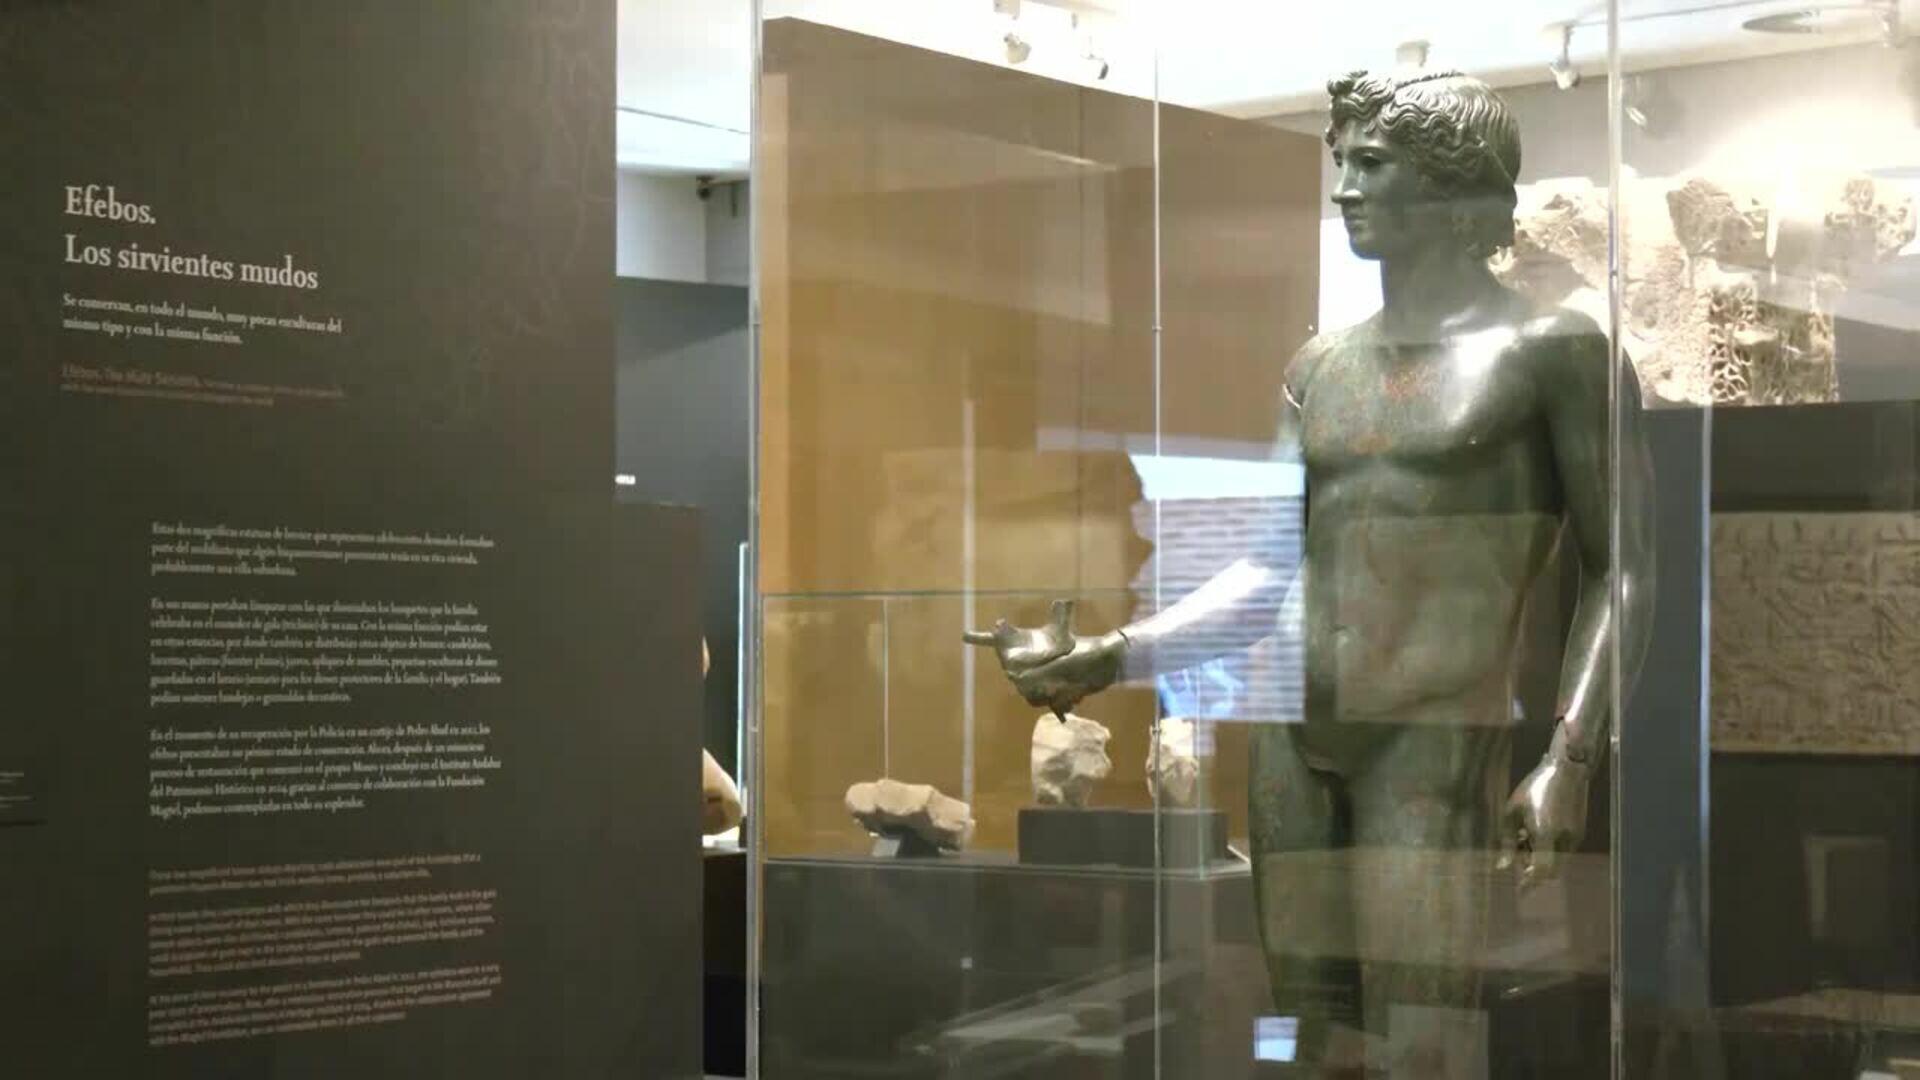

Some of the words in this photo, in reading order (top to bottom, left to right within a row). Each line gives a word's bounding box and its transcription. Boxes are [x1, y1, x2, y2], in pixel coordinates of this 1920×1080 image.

[65, 184, 156, 224] Efebos.
[65, 233, 111, 267] Los
[117, 243, 234, 281] sirvientes
[240, 254, 319, 289] mudos
